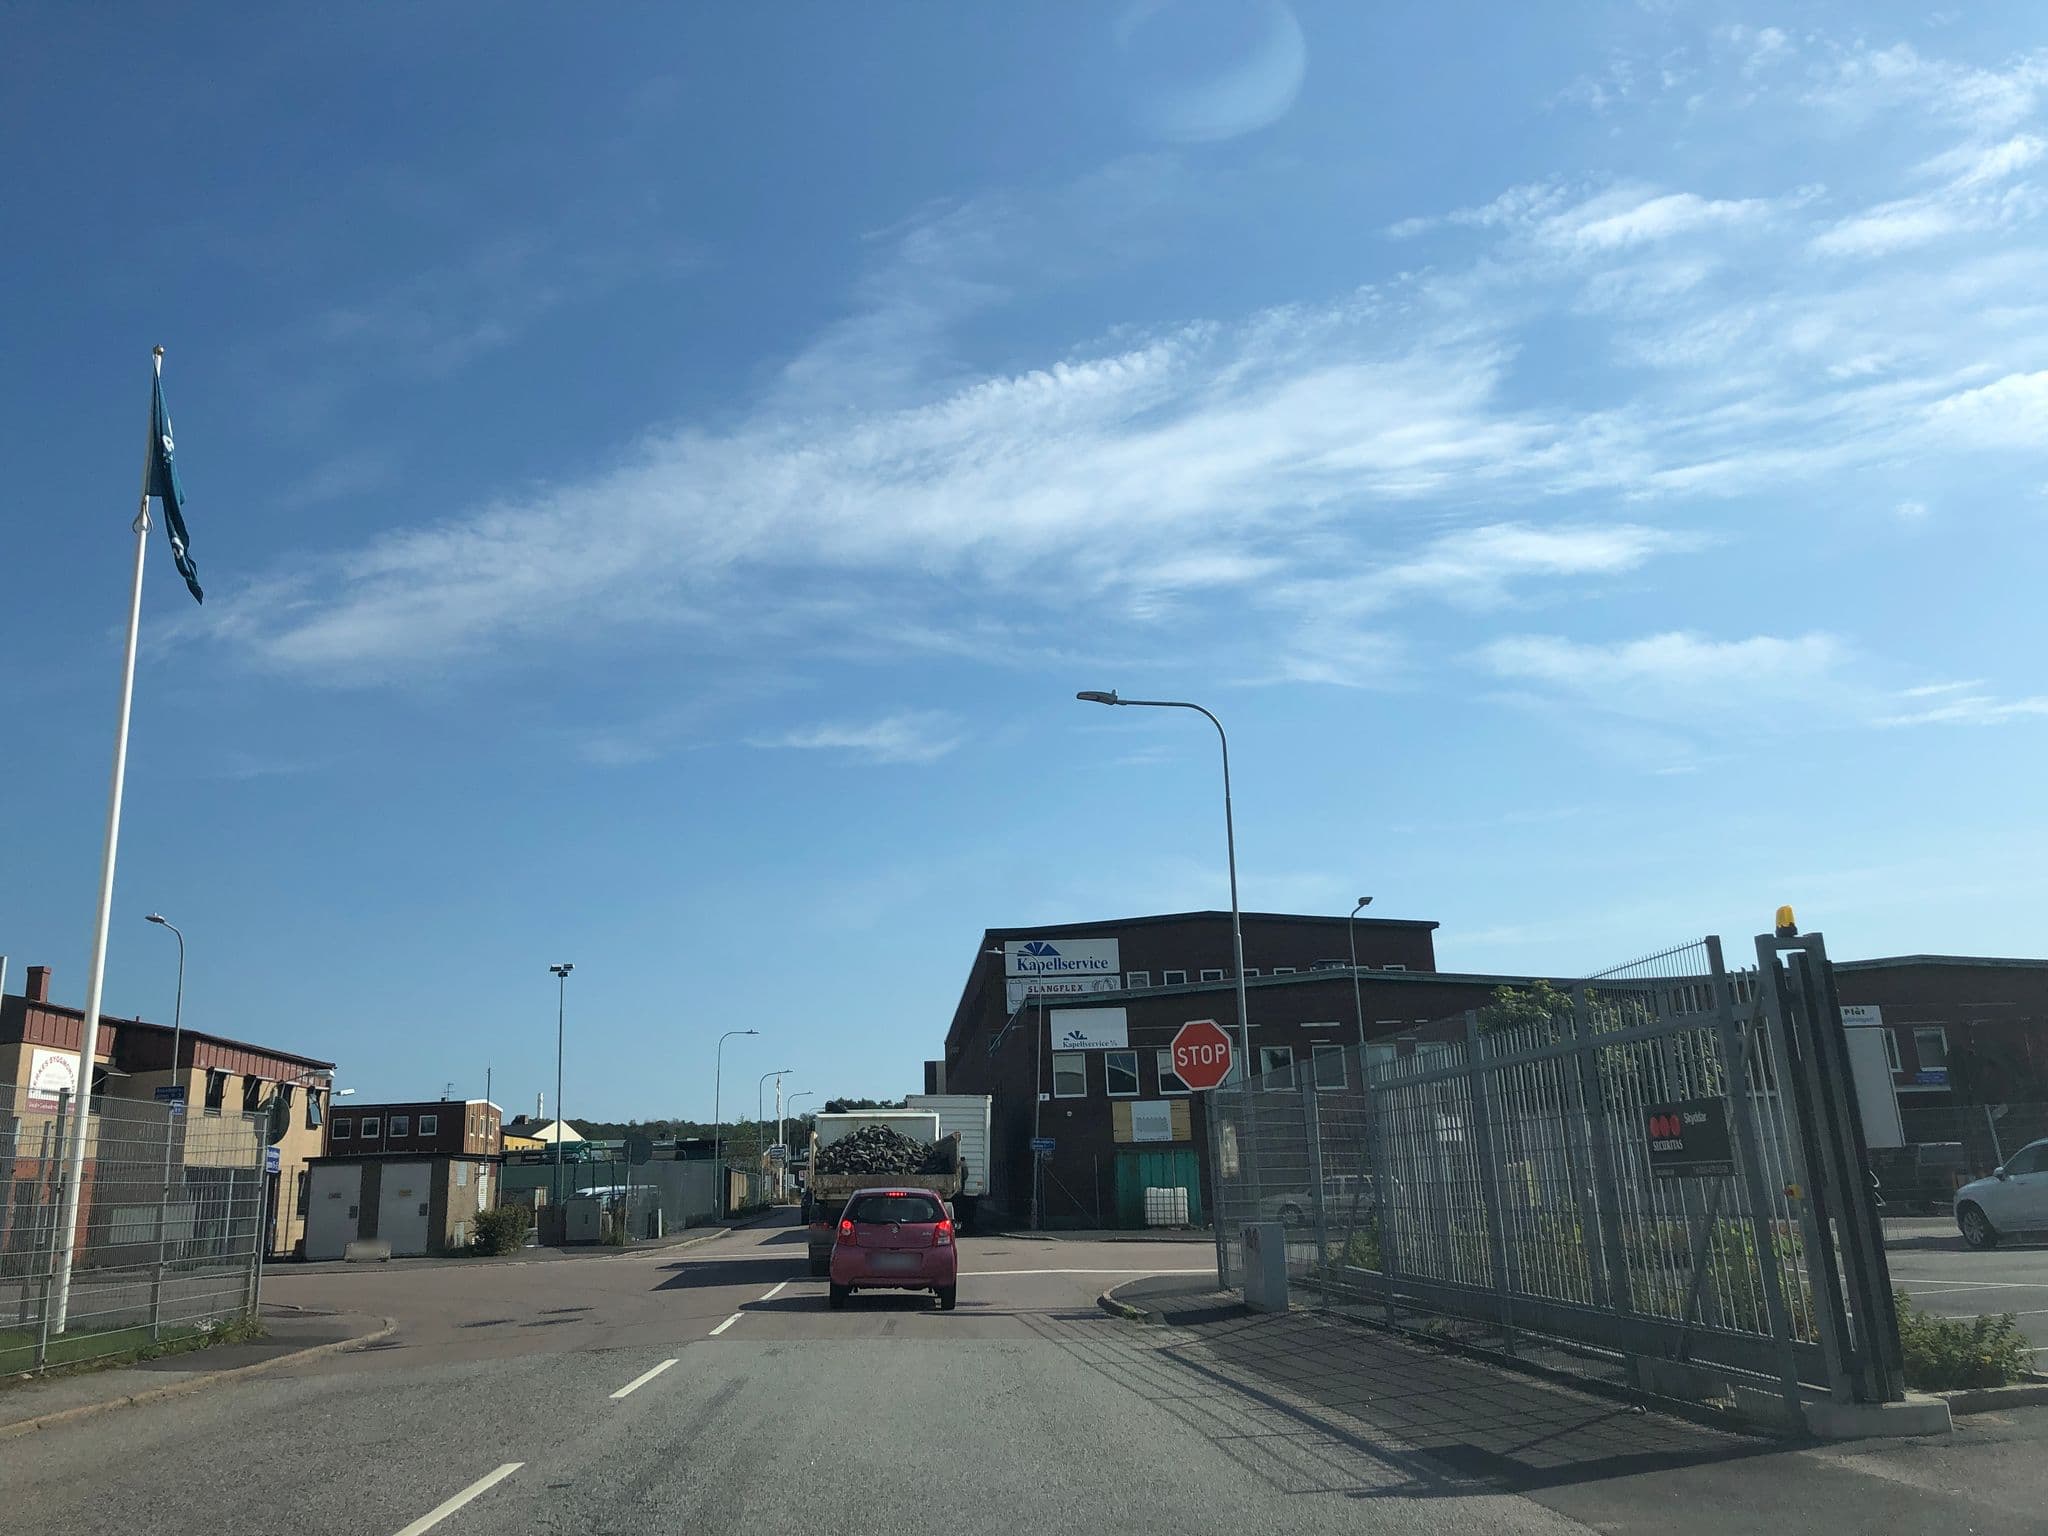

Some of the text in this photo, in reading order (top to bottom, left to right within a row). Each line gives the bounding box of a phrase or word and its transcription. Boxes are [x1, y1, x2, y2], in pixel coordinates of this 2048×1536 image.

[1017, 955, 1109, 974] Kapellservice
[1028, 984, 1083, 993] SLANGFLEX
[1844, 1007, 1866, 1016] Plåt
[1063, 1040, 1109, 1049] Kapellservice
[1177, 1044, 1226, 1067] STOP
[1652, 1138, 1684, 1152] SECURITAS
